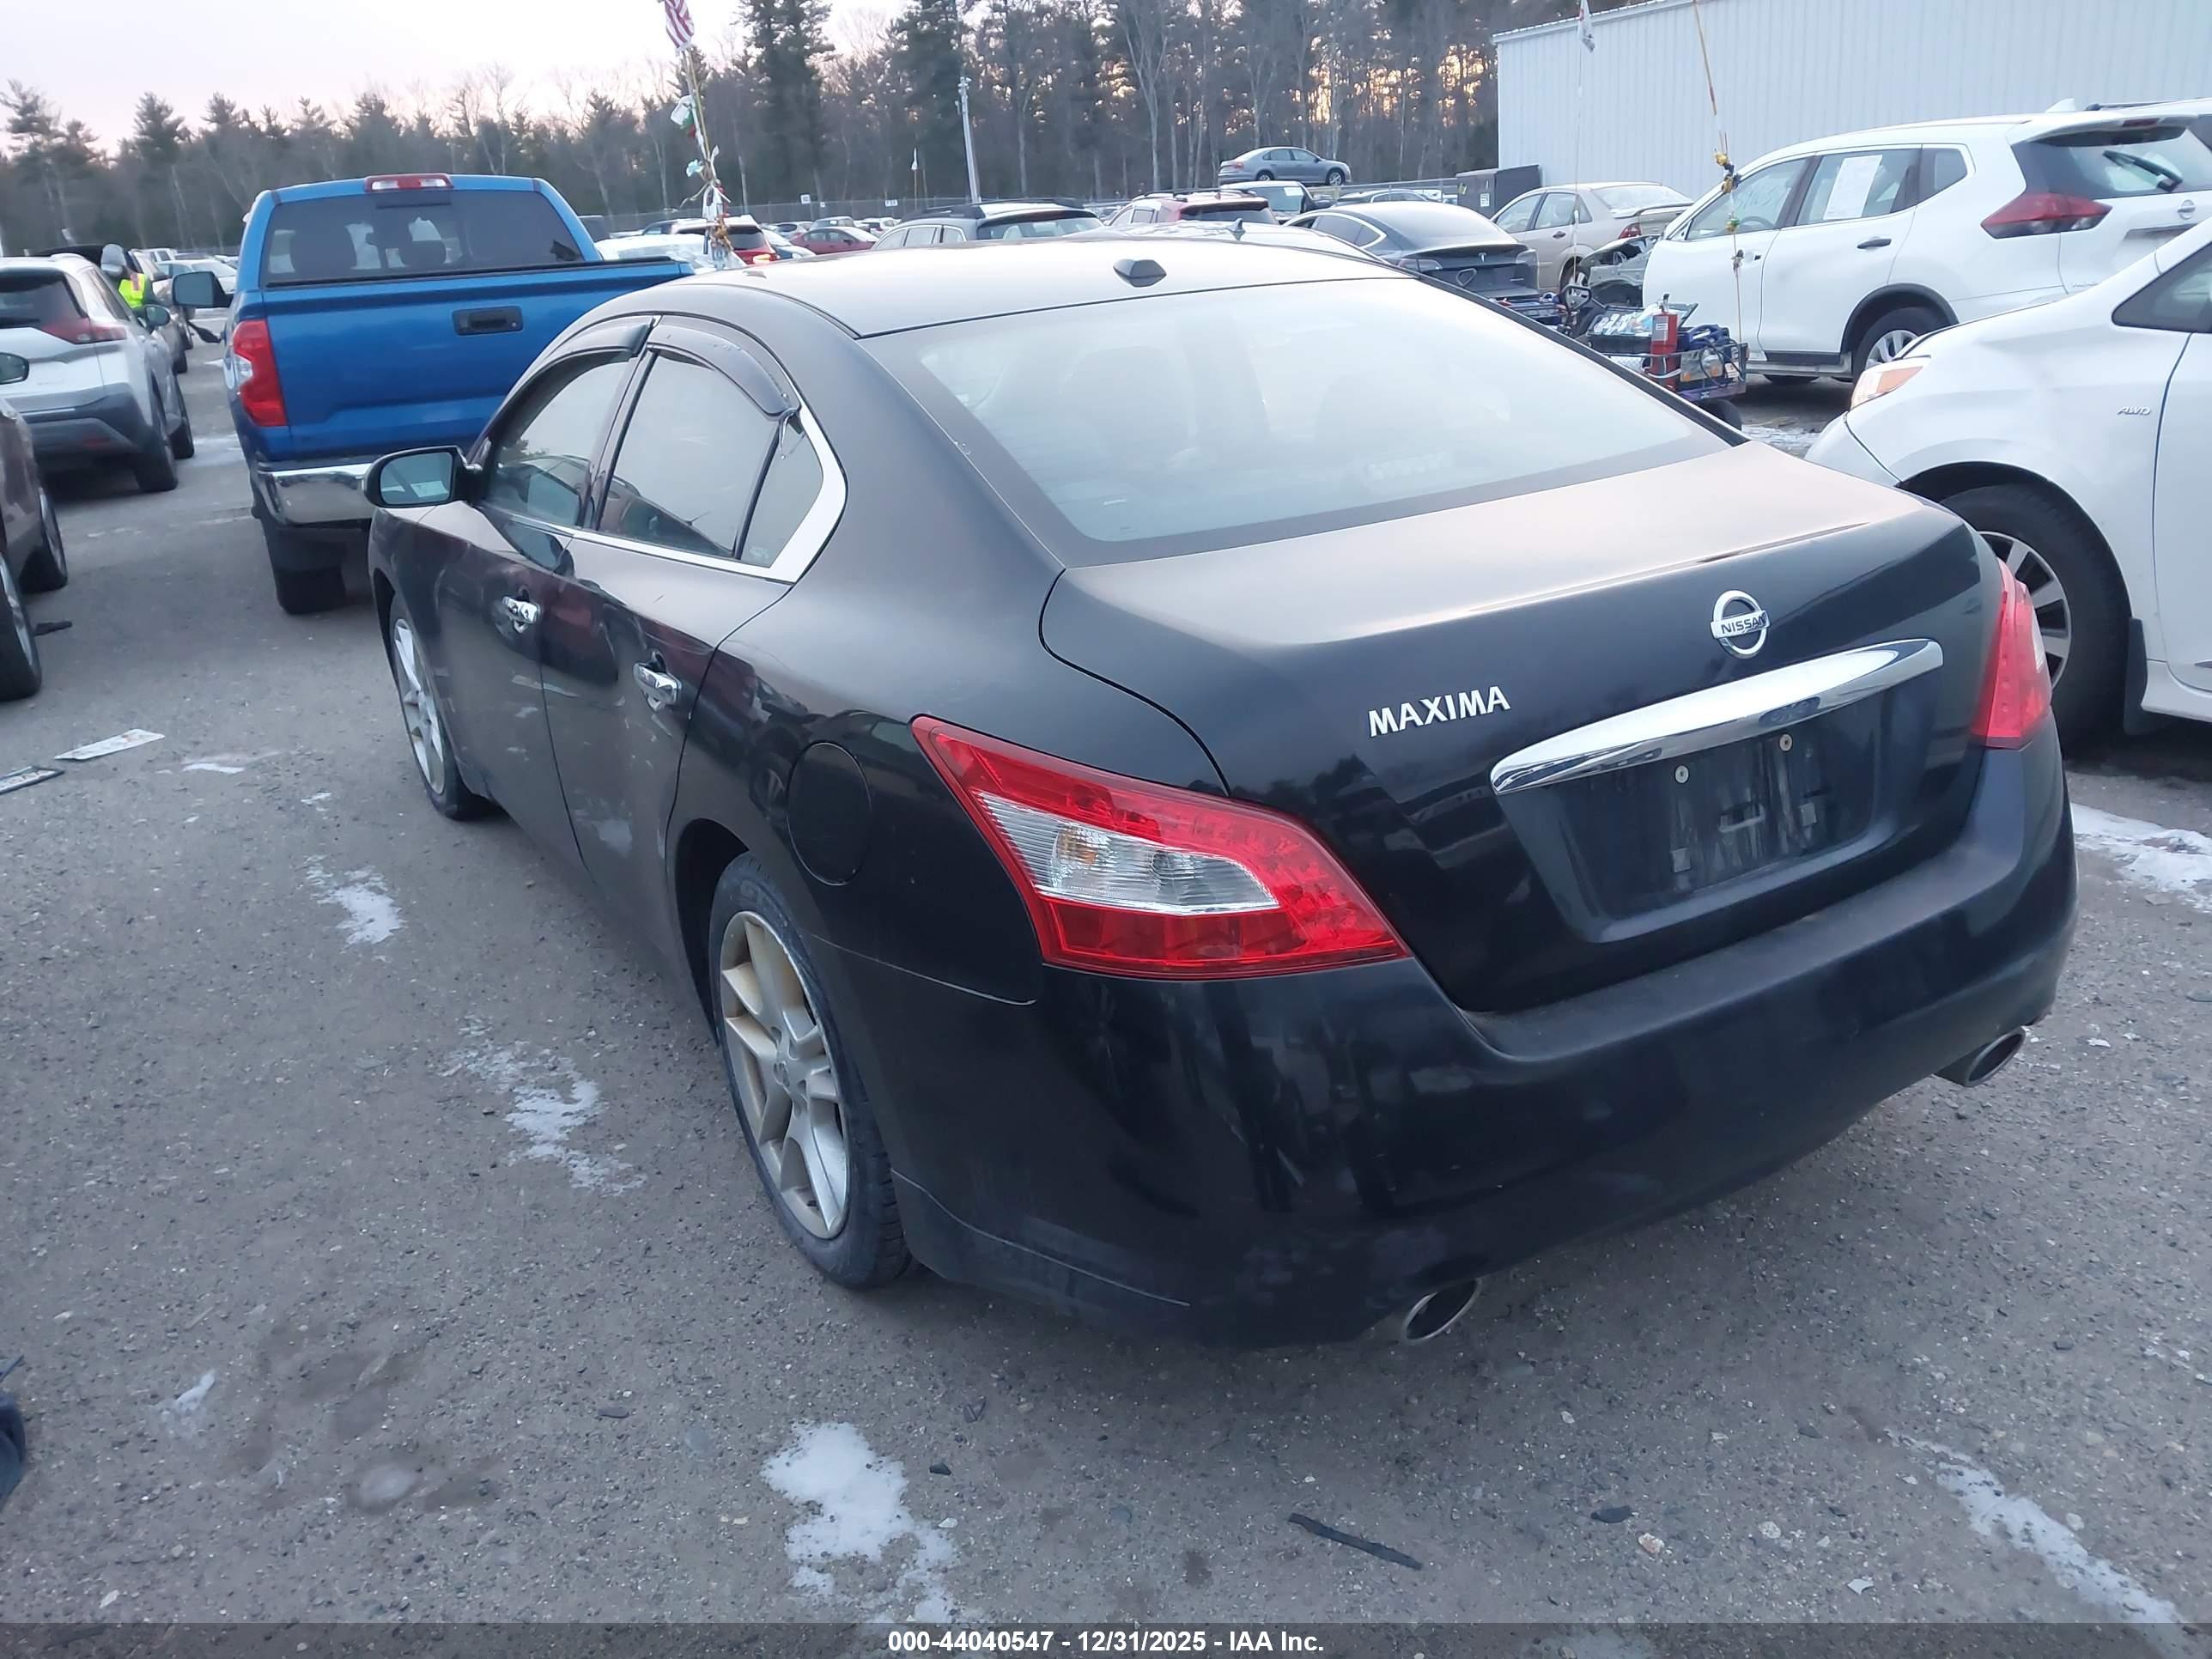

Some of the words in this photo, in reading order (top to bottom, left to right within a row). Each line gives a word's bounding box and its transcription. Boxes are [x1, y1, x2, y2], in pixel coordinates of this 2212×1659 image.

[2117, 406, 2152, 416] AWD
[1720, 612, 1767, 635] NISSAN
[1368, 685, 1511, 738] MAXIMA
